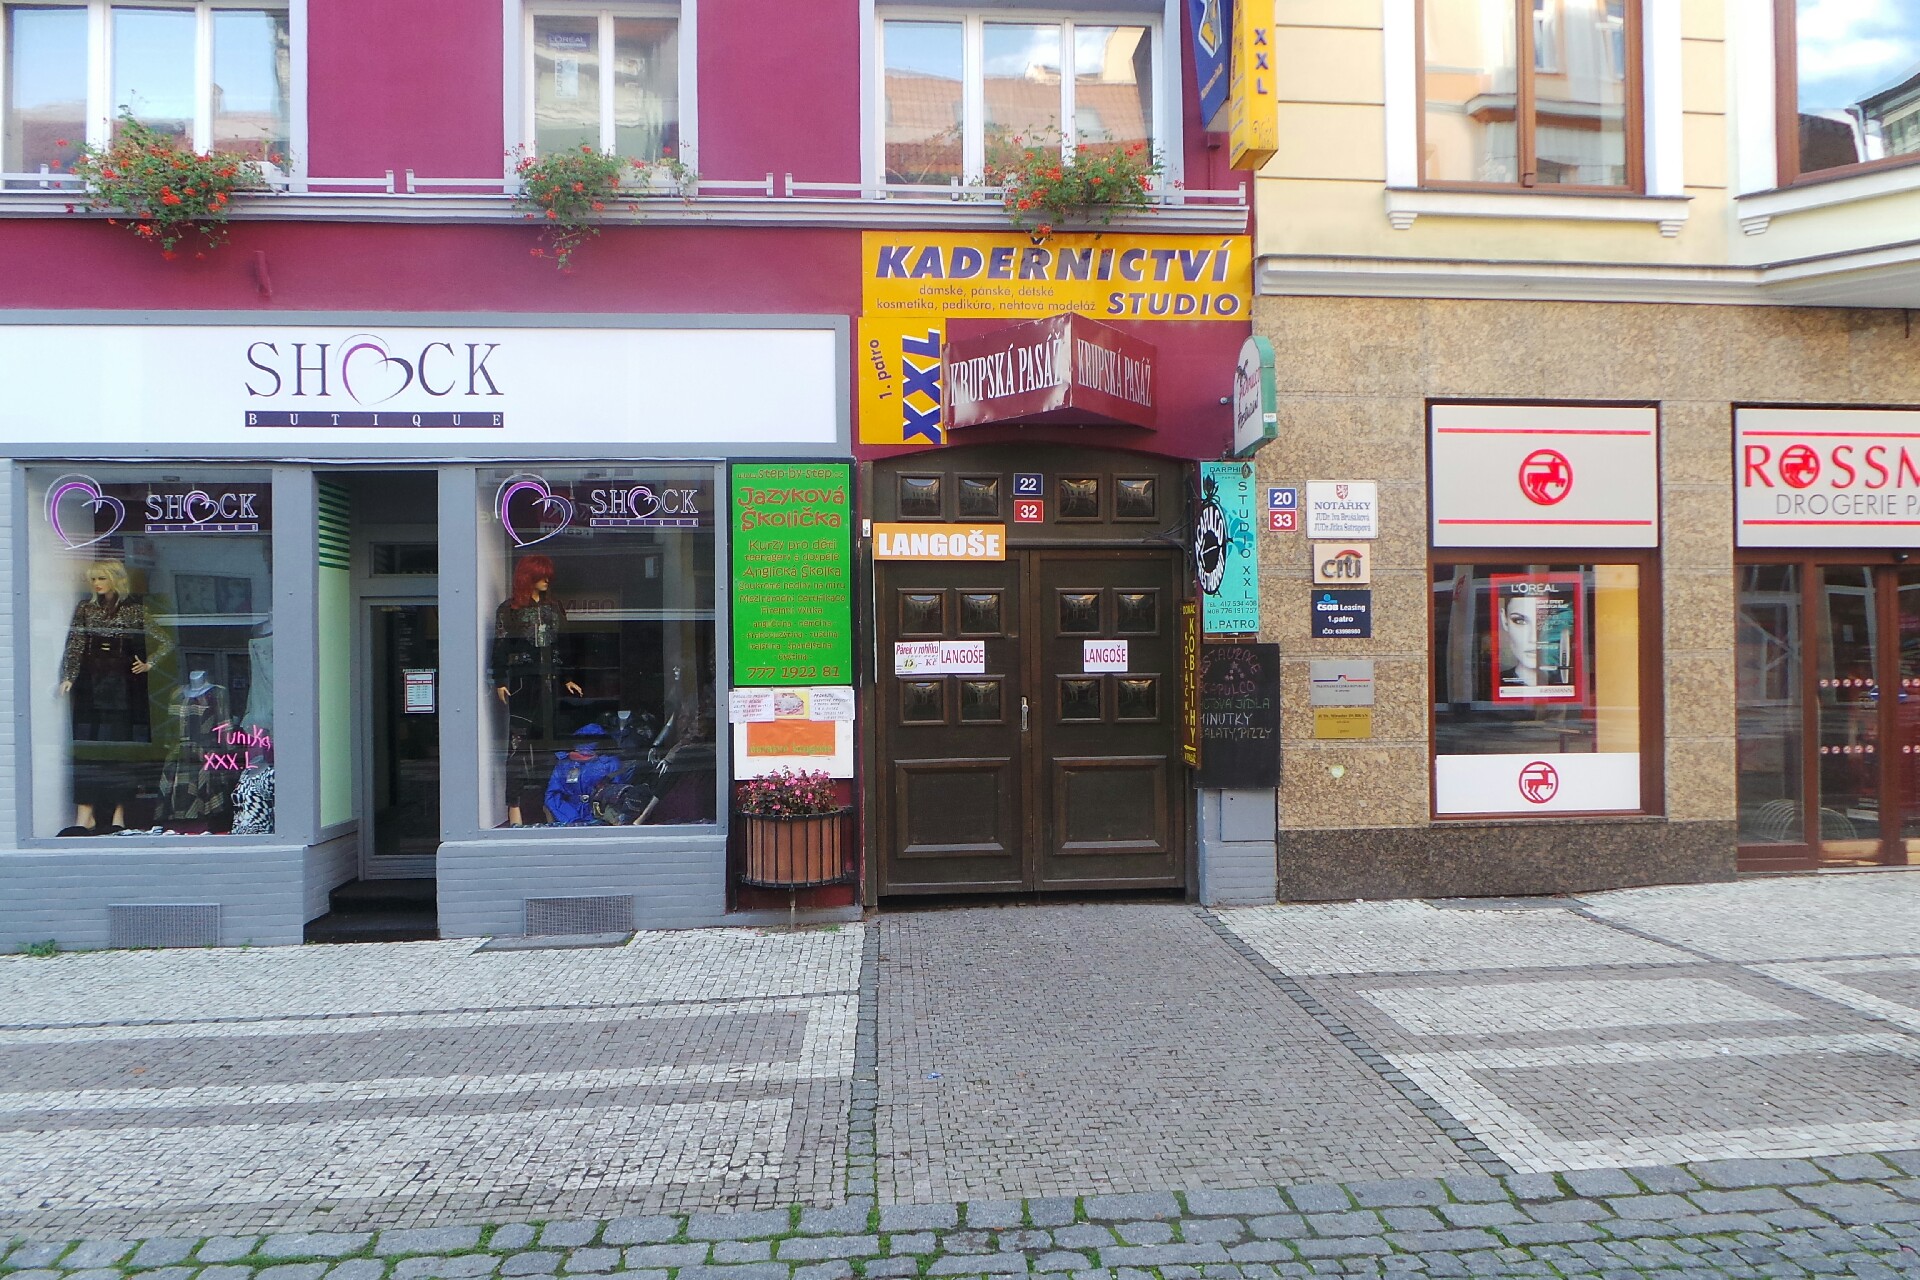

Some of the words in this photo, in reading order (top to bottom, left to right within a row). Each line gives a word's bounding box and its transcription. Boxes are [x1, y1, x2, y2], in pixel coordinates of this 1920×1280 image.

[1254, 28, 1268, 94] XXL
[876, 236, 1231, 282] KADEŘNICTVÍ
[919, 284, 966, 298] dámské,
[971, 285, 1015, 298] pánské,
[1018, 285, 1055, 297] dětské
[876, 298, 939, 312] kosmetika,
[942, 299, 996, 312] pedikúra,
[999, 299, 1044, 311] nehtová
[1048, 300, 1096, 312] modeláž
[1107, 292, 1241, 316] STUDIO
[245, 334, 504, 406] SHOCK
[869, 338, 892, 381] patro
[949, 348, 1016, 408] KRUPSKÁ
[1018, 332, 1063, 396] PASÁŽ
[1077, 337, 1124, 400] KRUPSKÁ
[1123, 351, 1152, 408] PASÁŽ
[902, 328, 941, 444] XXL
[248, 412, 501, 427] BUTIQUE
[1020, 477, 1037, 491] 22
[145, 490, 258, 524] SHOCK
[590, 486, 699, 519] SHOCK
[737, 485, 845, 507] Jazyková
[1273, 491, 1292, 506] 20
[1776, 494, 1897, 515] DROGERIE
[741, 506, 842, 531] Školička
[1020, 504, 1038, 519] 32
[1238, 481, 1251, 560] STUDIO
[1273, 513, 1293, 527] 33
[749, 540, 784, 551] Kurzy
[788, 541, 809, 551] pro
[812, 538, 836, 550] děti
[878, 529, 1000, 557] LANGOŠE
[743, 565, 797, 578] Anglická
[801, 563, 842, 578] Školka
[1321, 554, 1362, 578] citi
[1242, 565, 1253, 600] XXL
[1340, 603, 1366, 613] Leasing
[896, 643, 912, 655] Párek
[914, 646, 918, 654] v
[940, 645, 984, 664] LANGOŠE
[1084, 644, 1126, 663] LANGOŠE
[747, 667, 776, 678] 777
[781, 666, 817, 679] 1922
[822, 666, 840, 677] 81
[1188, 617, 1196, 744] KOBLIHY
